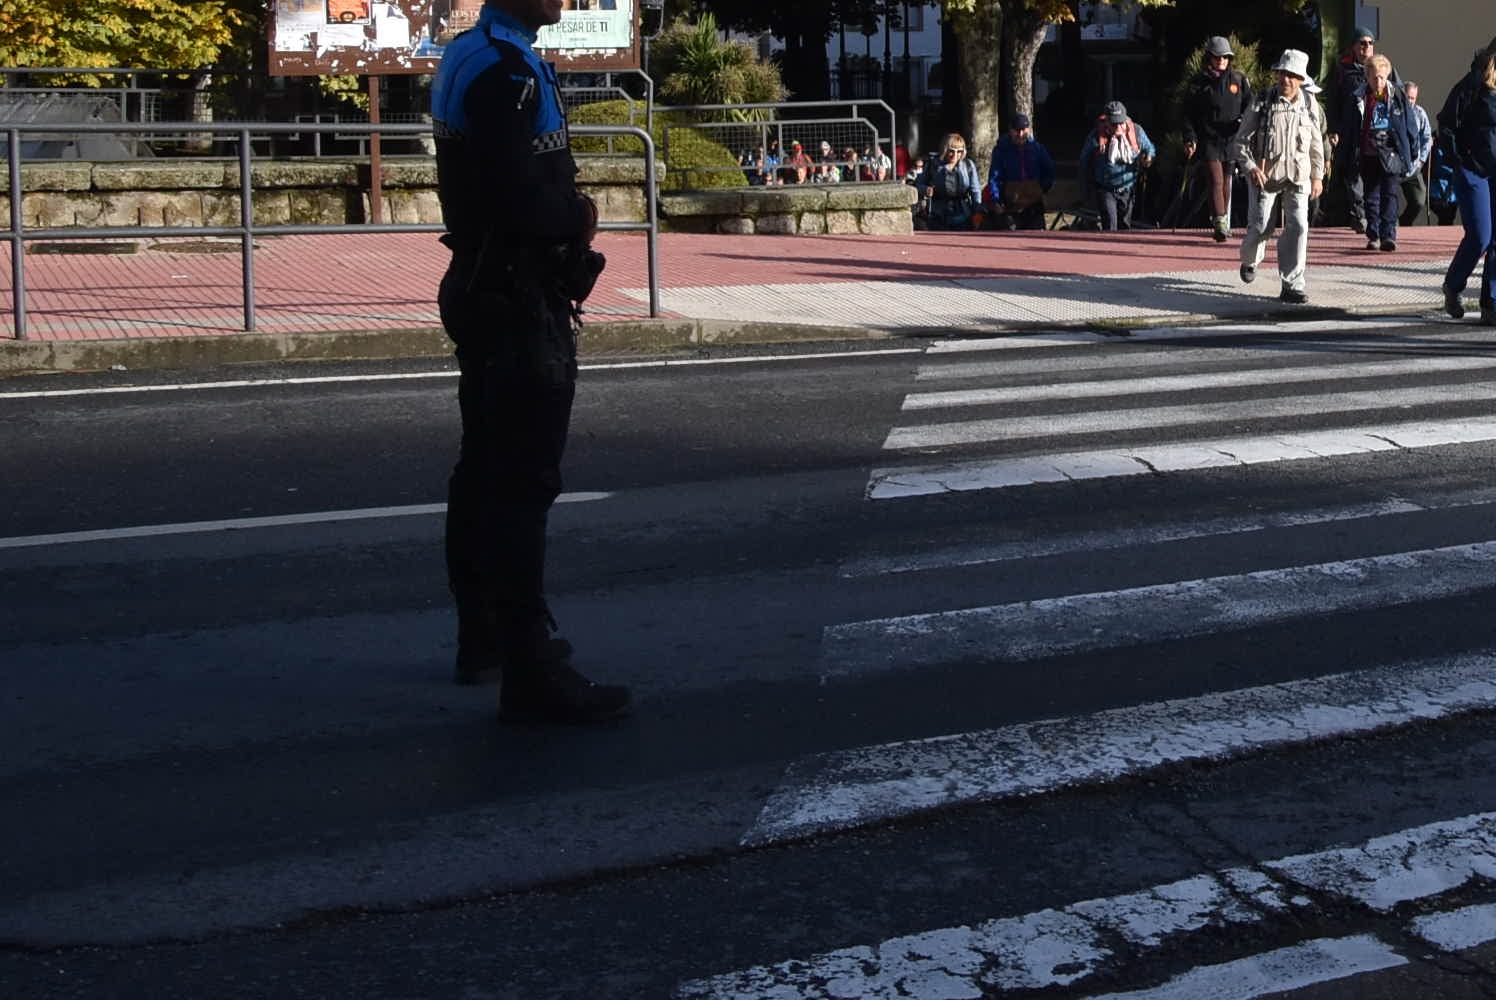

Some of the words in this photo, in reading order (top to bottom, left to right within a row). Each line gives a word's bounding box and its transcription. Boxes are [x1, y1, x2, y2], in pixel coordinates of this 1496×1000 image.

[557, 21, 584, 33] PESAR
[586, 21, 598, 33] DE
[600, 21, 609, 33] TI
